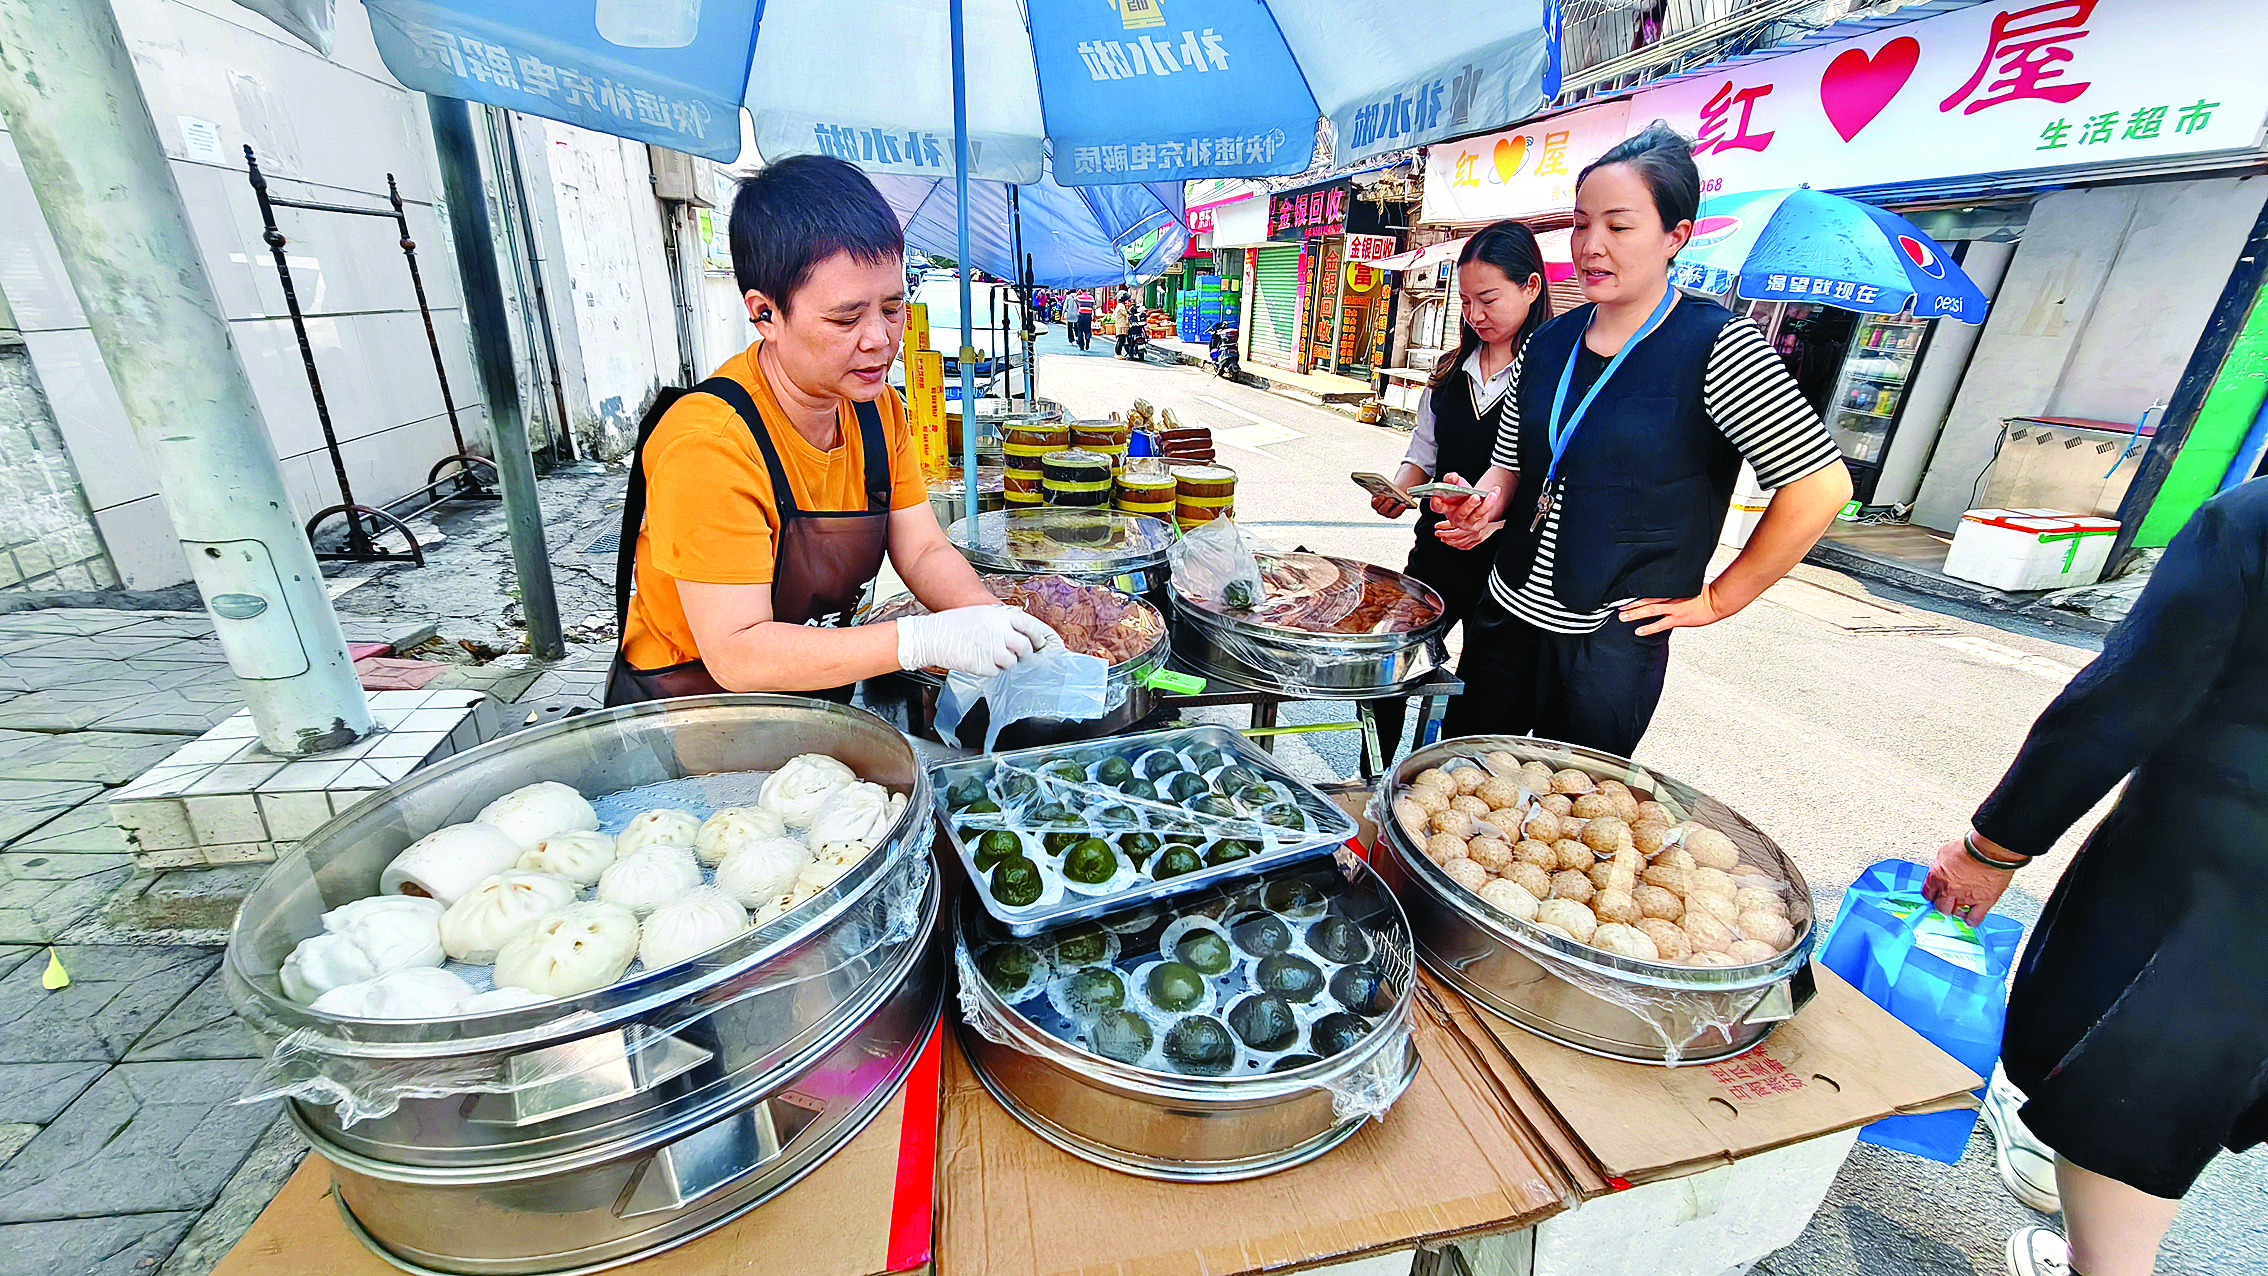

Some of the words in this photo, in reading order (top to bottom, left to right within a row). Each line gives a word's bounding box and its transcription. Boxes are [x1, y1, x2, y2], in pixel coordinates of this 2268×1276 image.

[1690, 81, 1775, 157] 红
[1939, 0, 2101, 117] 屋
[2035, 98, 2220, 152] 生活超市
[1452, 150, 1480, 188] 红
[1534, 130, 1569, 176] 屋
[1278, 187, 1342, 229] 金银回收
[1350, 236, 1394, 259] 金银回收
[1317, 250, 1340, 342] 金银回收
[1354, 262, 1374, 286] 富
[1765, 274, 1881, 304] 渴望就现在
